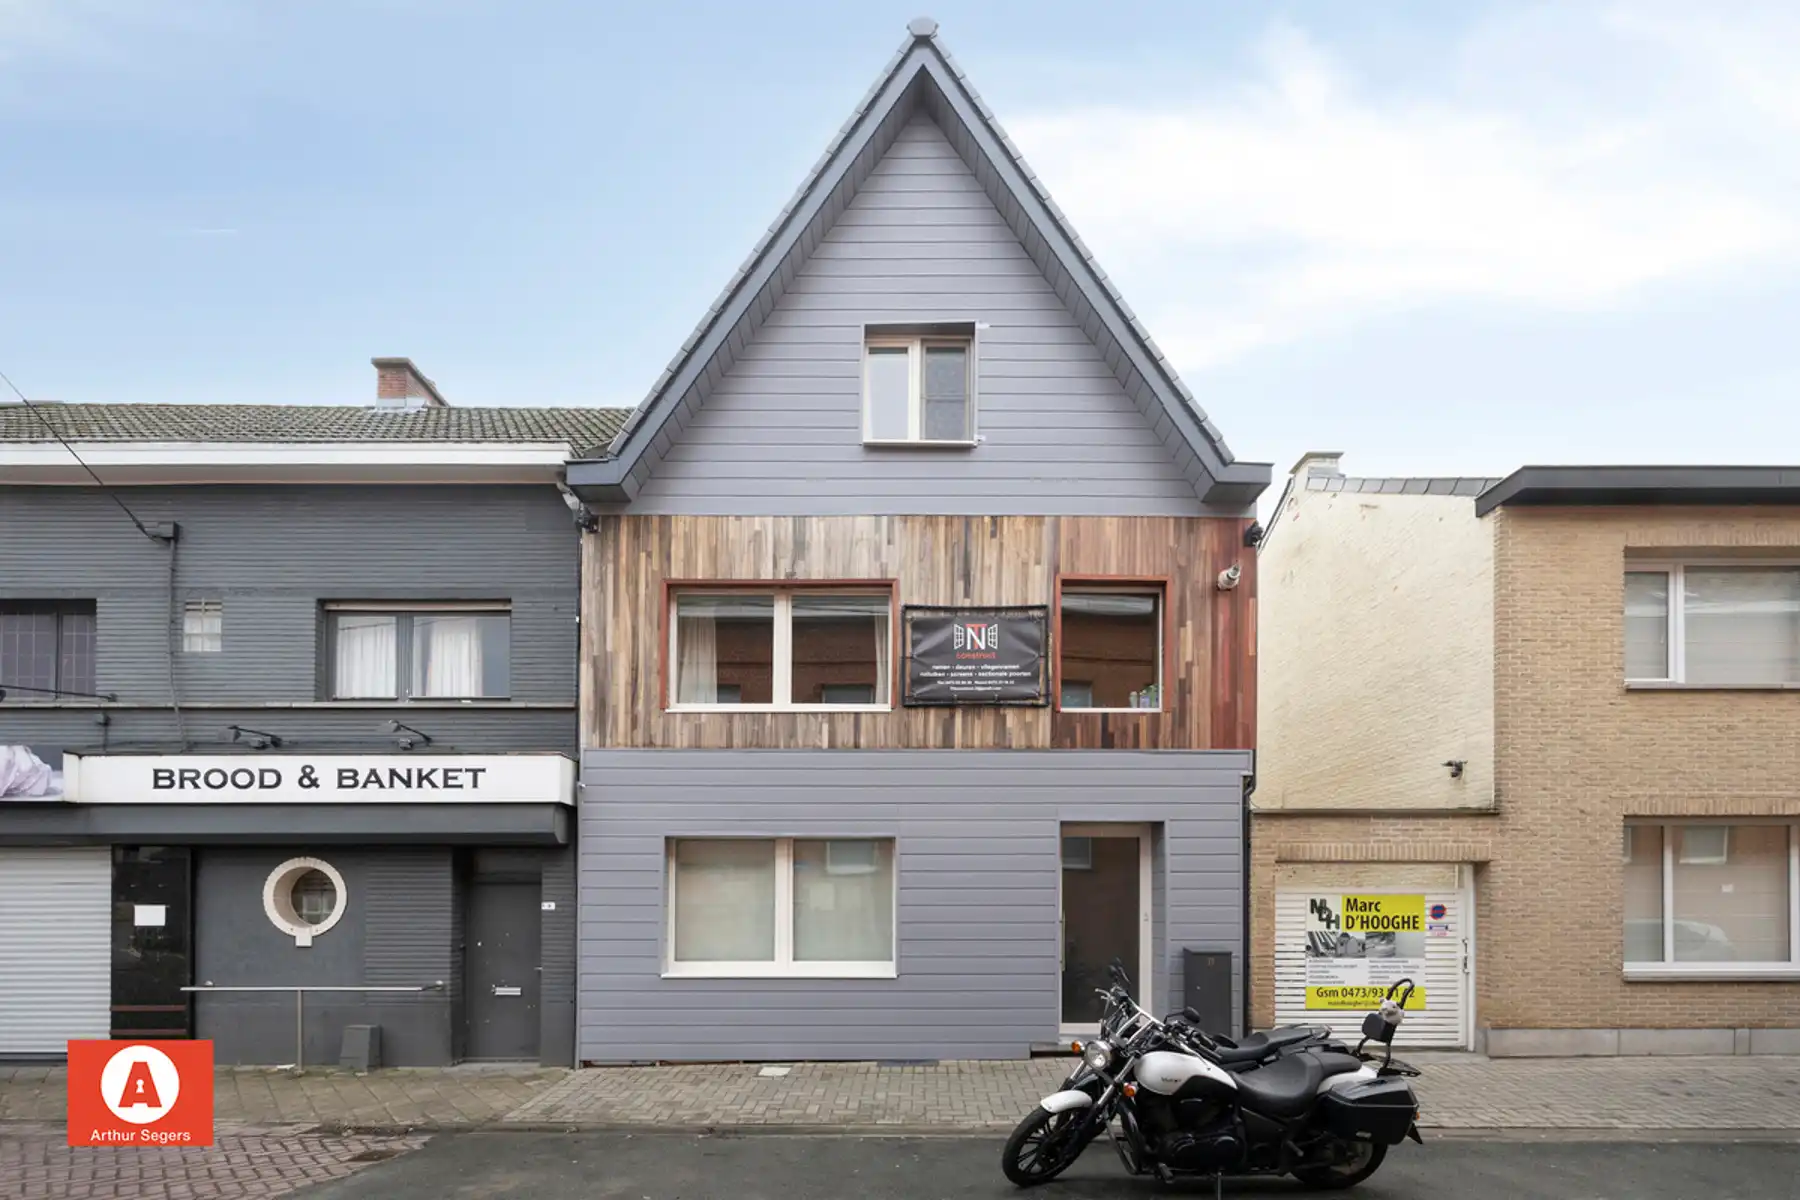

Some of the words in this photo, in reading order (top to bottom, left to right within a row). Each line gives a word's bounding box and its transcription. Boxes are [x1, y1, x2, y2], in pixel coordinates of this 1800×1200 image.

[956, 651, 997, 660] construct
[152, 768, 283, 790] BROOD
[298, 764, 320, 790] &
[336, 768, 487, 790] BANKET
[1345, 897, 1381, 913] Marc
[1345, 914, 1420, 930] D'HOOGHE
[1316, 987, 1339, 998] Gsm
[1341, 987, 1384, 999] 0473/93
